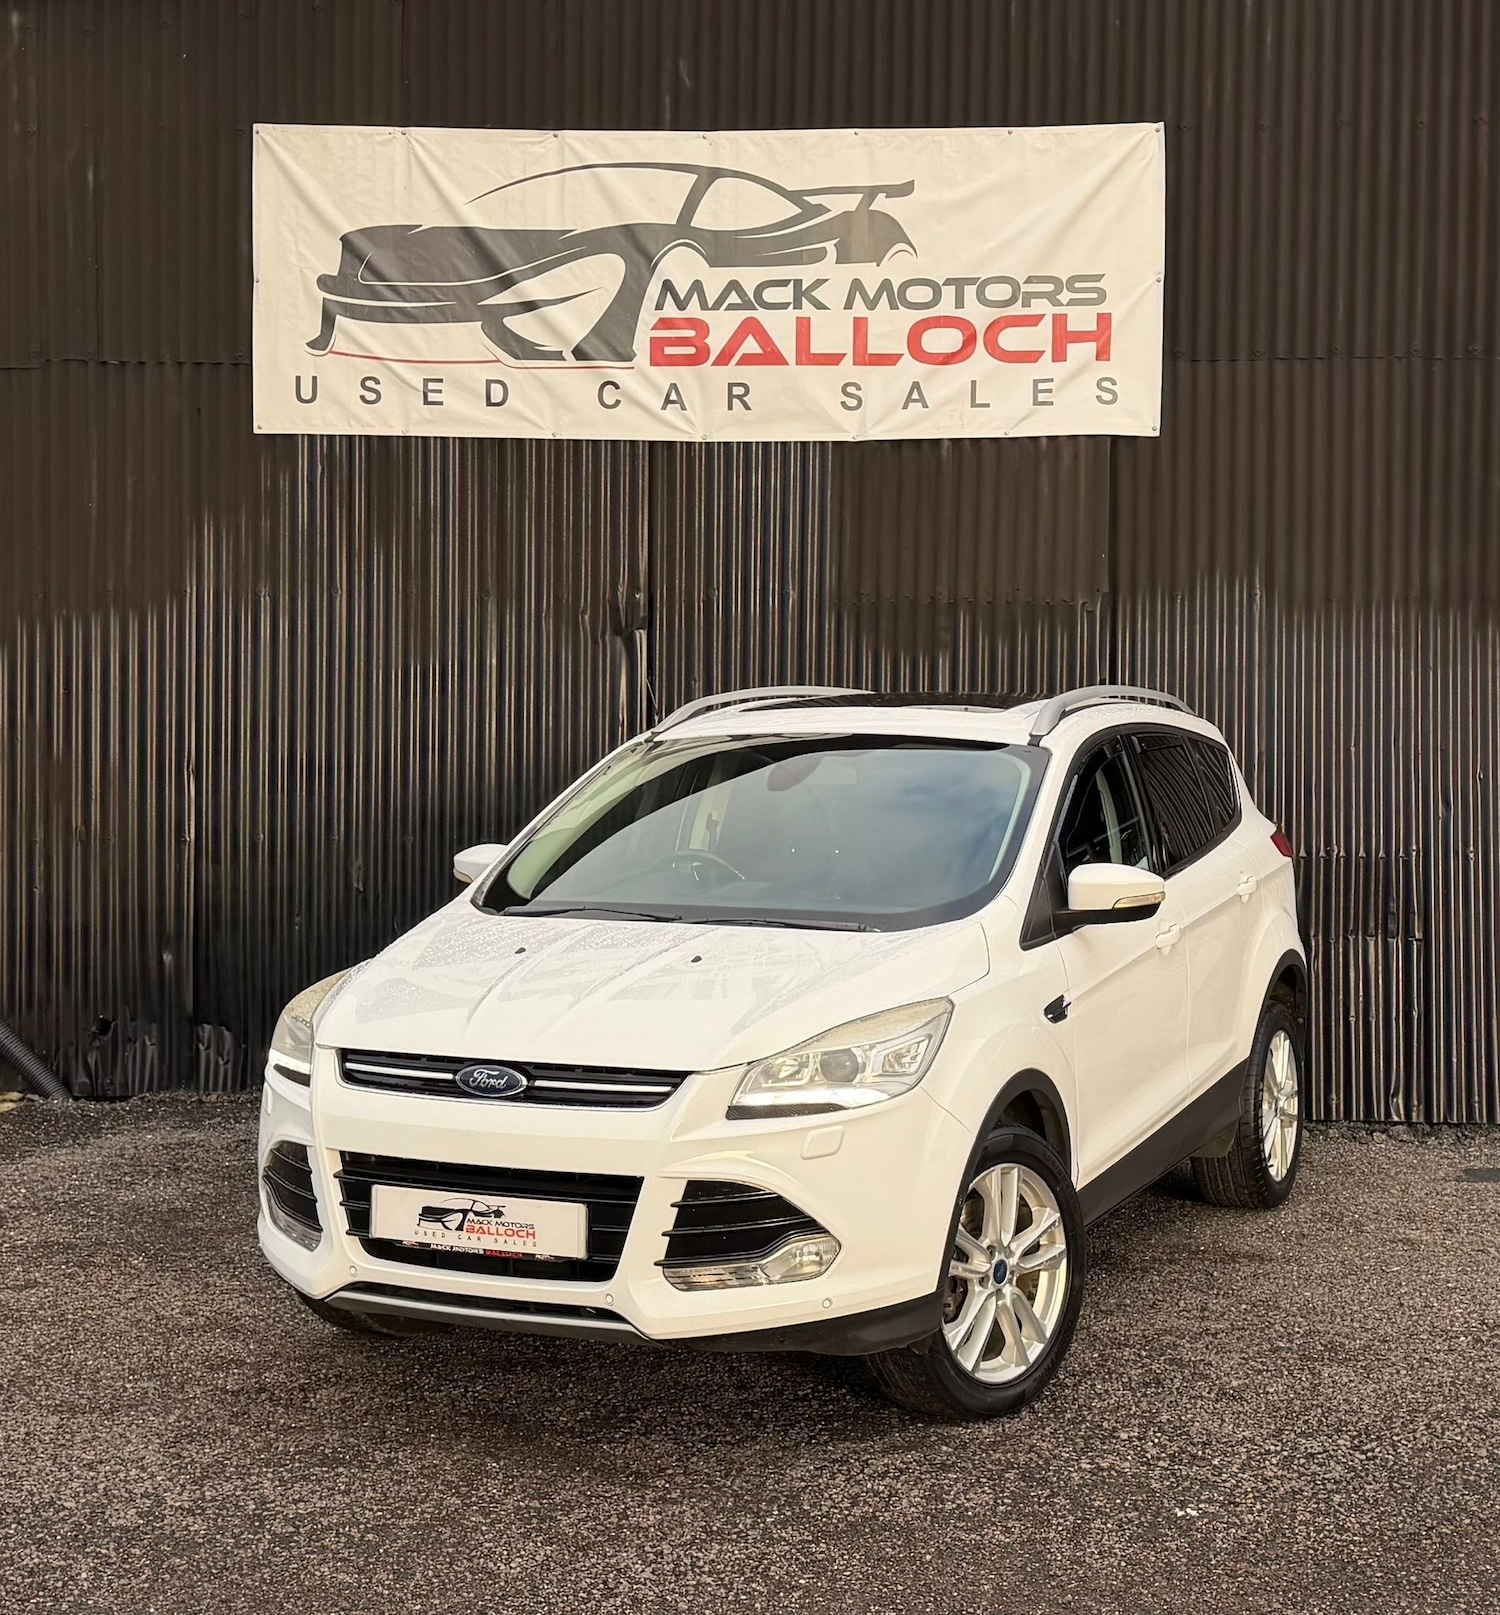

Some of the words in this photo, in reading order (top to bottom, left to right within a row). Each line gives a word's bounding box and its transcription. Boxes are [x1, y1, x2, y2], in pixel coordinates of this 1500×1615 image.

[654, 277, 830, 312] MACK
[843, 273, 1107, 311] MOTORS
[648, 313, 1112, 367] BALLOCH
[295, 375, 511, 409] USED
[597, 380, 752, 412] CAR
[840, 376, 1119, 411] SALES
[469, 1068, 508, 1089] Ford
[465, 1225, 536, 1239] BALLOCH
[466, 1218, 493, 1226] MACK
[495, 1220, 535, 1229] MOTORS
[415, 1230, 446, 1238] USED
[458, 1234, 482, 1242] CAR
[494, 1238, 537, 1247] SALES
